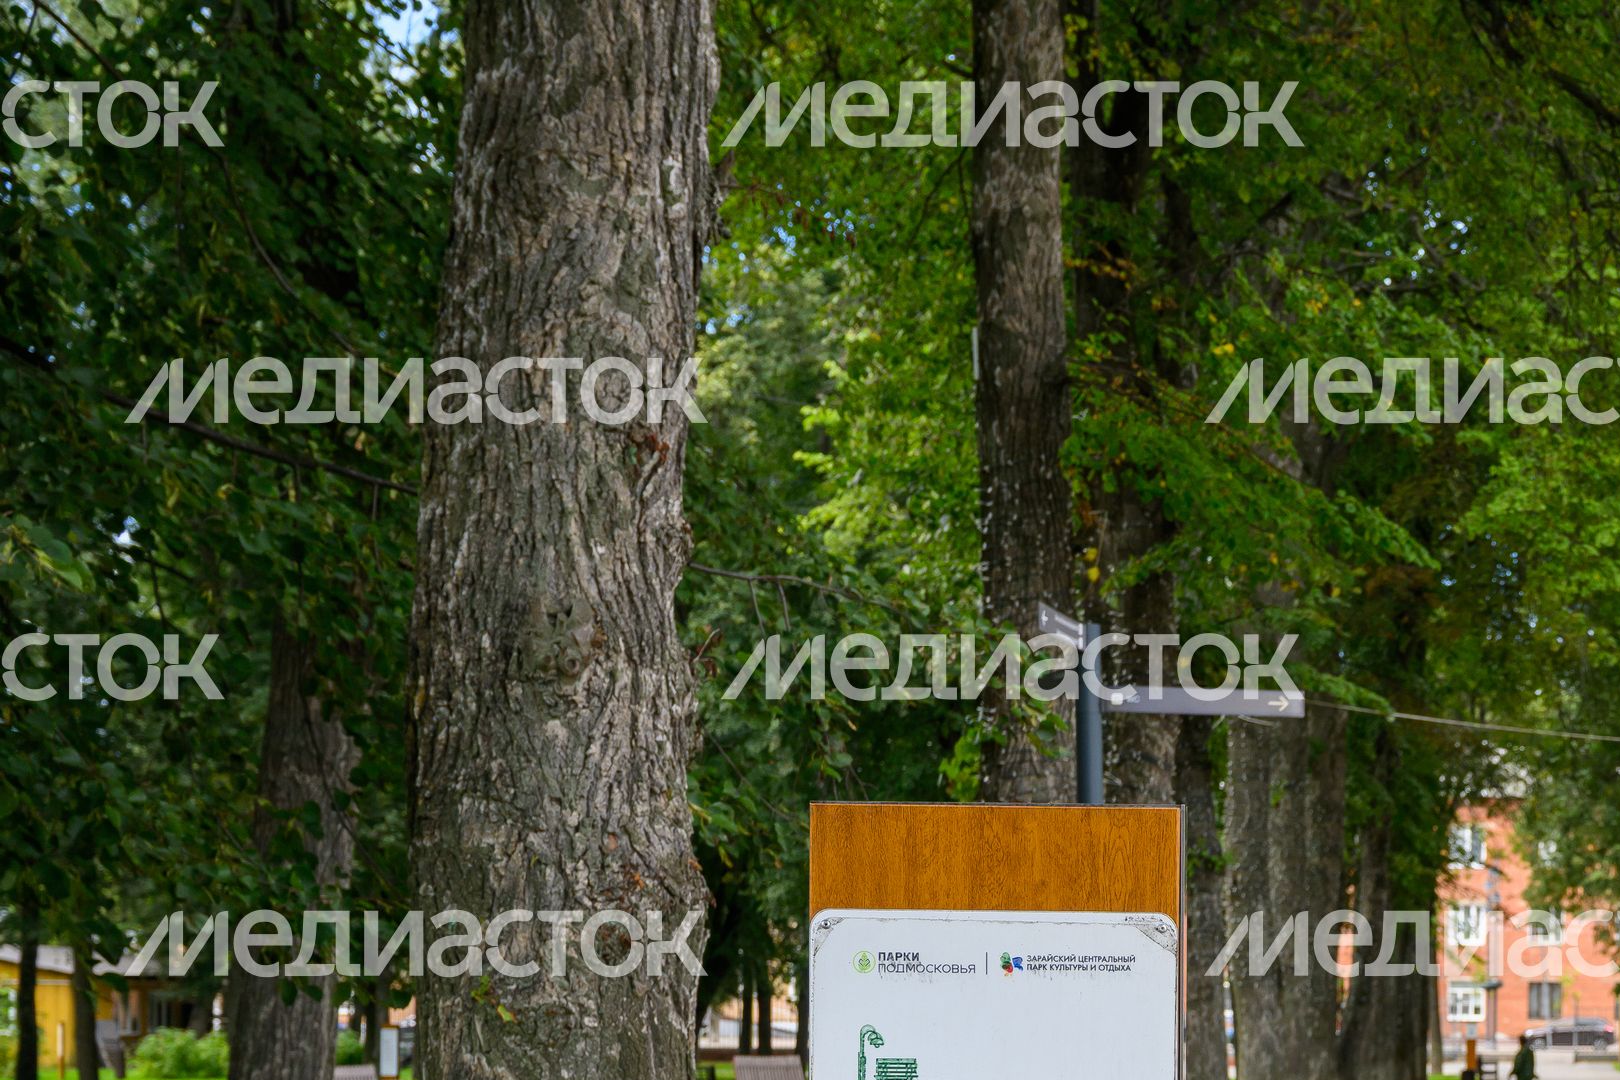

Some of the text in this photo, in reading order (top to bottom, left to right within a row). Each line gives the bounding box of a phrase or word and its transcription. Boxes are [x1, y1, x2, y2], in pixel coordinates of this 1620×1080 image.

[878, 951, 920, 962] ПАРКИ
[1026, 954, 1136, 965] ЗАРАЙСКИЙ ЦЕНТРАЛЬНЫЙ
[878, 963, 976, 974] ПОДМОСКОВЬЯ
[1026, 964, 1047, 972] ПАРК
[1049, 964, 1088, 973] КУЛЬТУРЫ
[1099, 964, 1131, 973] ОТДЫХА
